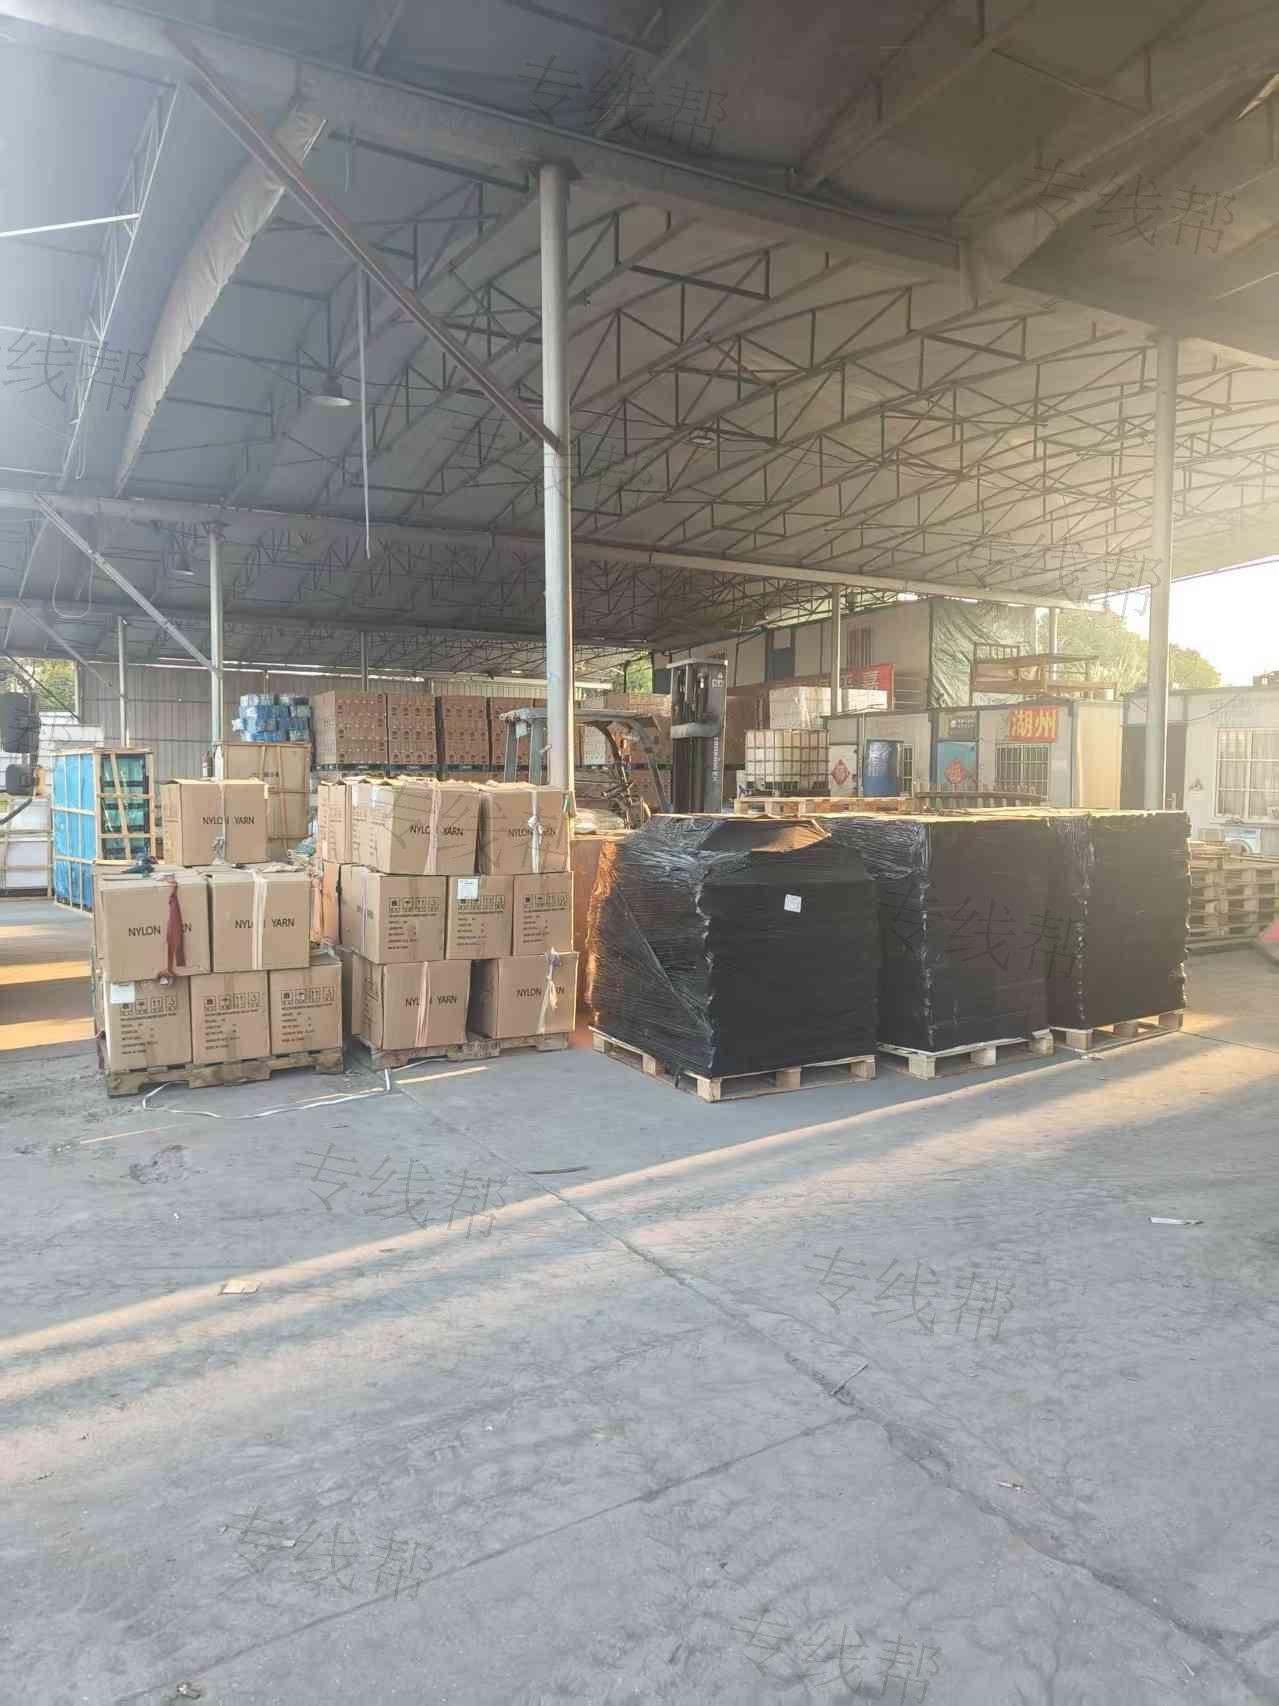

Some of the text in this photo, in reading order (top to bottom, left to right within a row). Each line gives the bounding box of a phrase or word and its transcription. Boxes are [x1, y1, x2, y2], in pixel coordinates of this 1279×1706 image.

[234, 815, 255, 825] YARN
[271, 917, 296, 928] YARN
[128, 925, 161, 937] NYLON
[437, 994, 457, 1005] YARN
